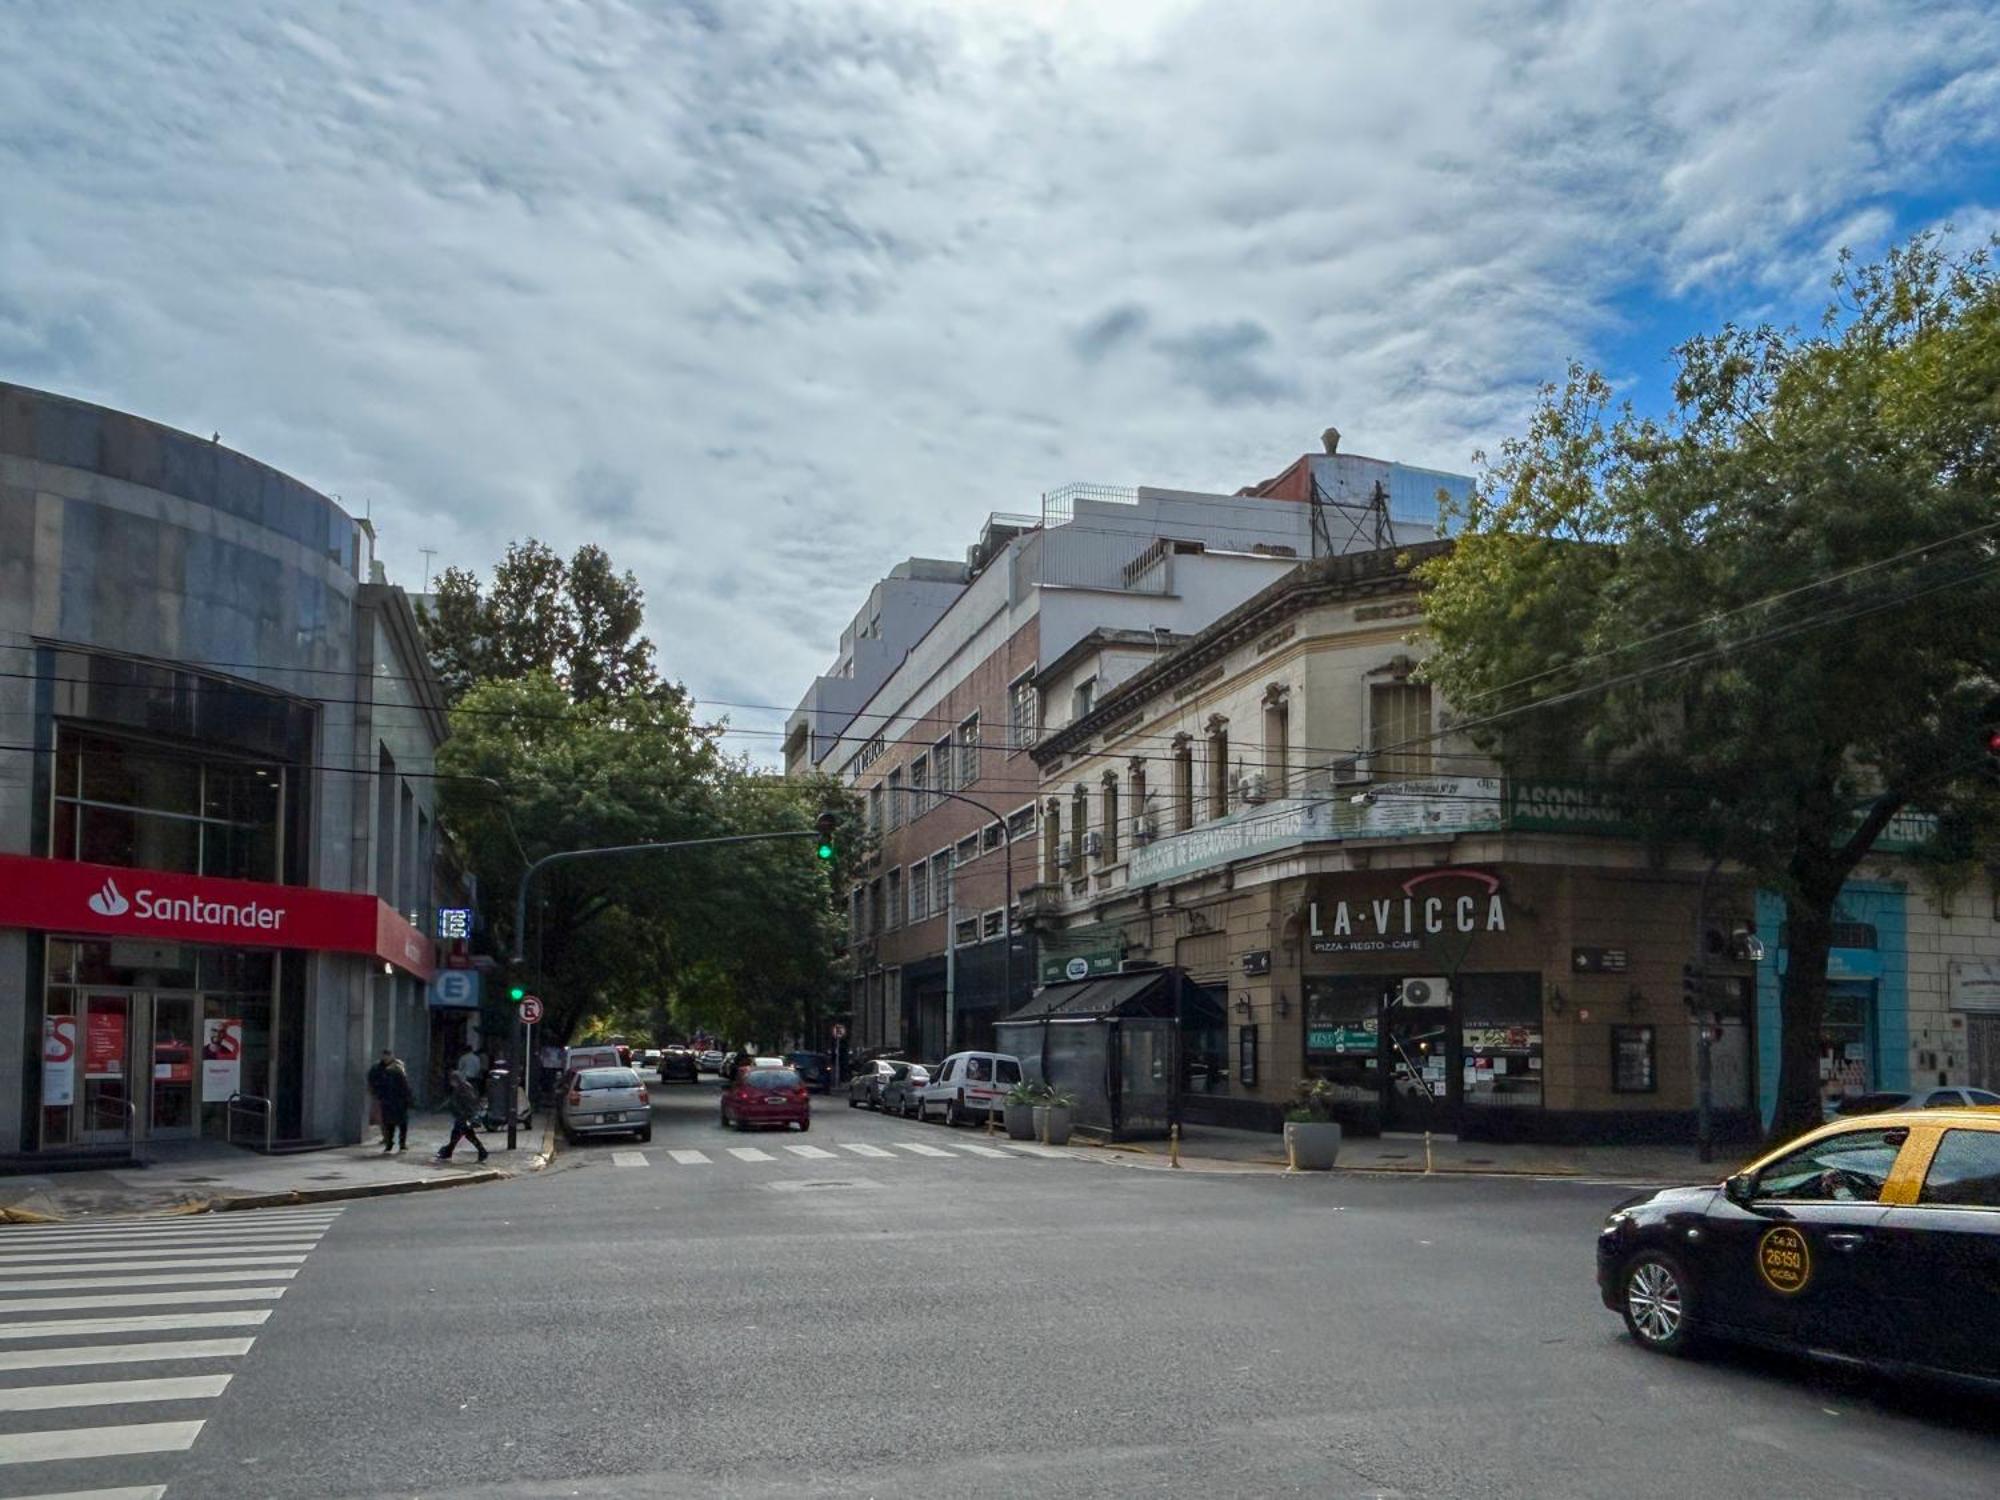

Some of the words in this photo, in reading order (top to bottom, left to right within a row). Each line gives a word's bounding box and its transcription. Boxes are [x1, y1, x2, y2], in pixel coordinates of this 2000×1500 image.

[134, 889, 285, 929] Santander
[1315, 942, 1343, 952] PIZZA
[1350, 941, 1384, 951] RESTO
[444, 977, 464, 998] E
